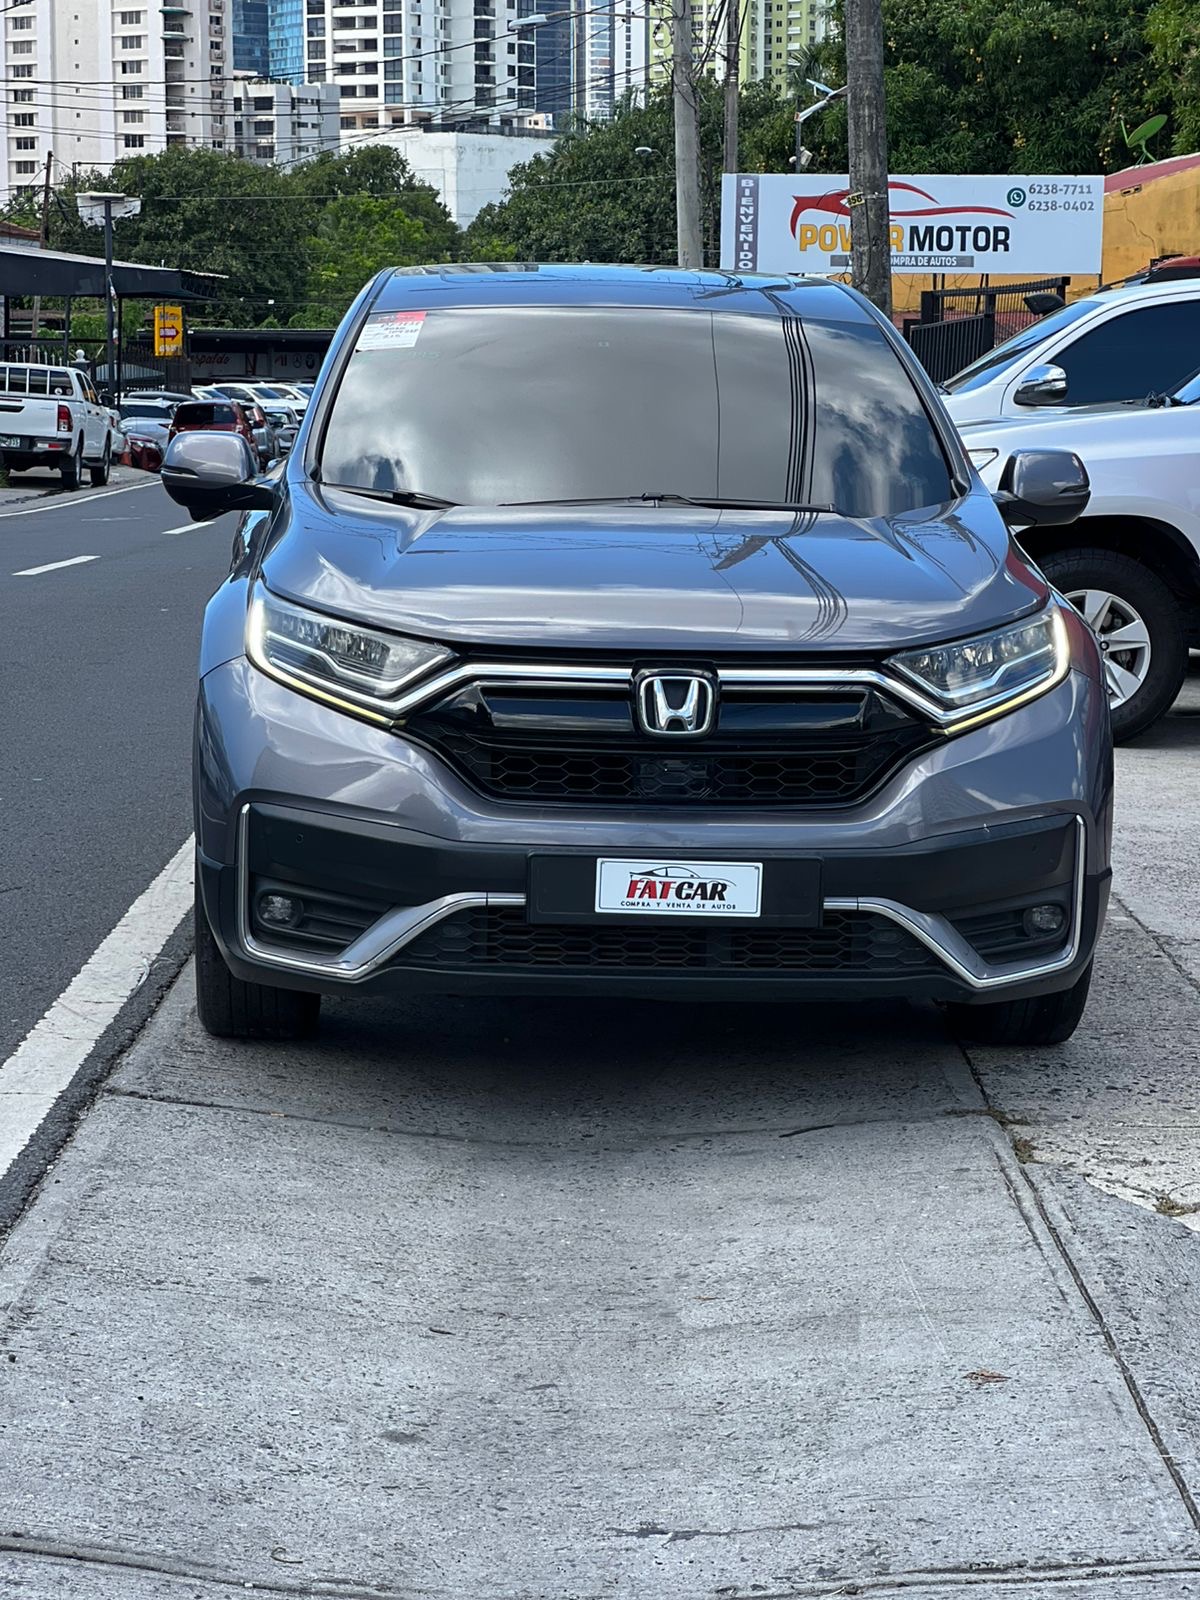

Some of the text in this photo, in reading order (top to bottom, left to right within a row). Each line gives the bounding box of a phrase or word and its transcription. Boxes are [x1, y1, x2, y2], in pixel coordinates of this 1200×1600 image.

[1028, 183, 1093, 195] 6238-7711
[1027, 200, 1095, 212] 6238-0402
[738, 178, 755, 272] BIENVENIDO
[799, 223, 1010, 252] POR MOTOR
[917, 256, 929, 266] DE
[929, 256, 957, 266] AUTOS
[626, 879, 728, 901] FATCAR
[620, 900, 651, 908] COMPRA
